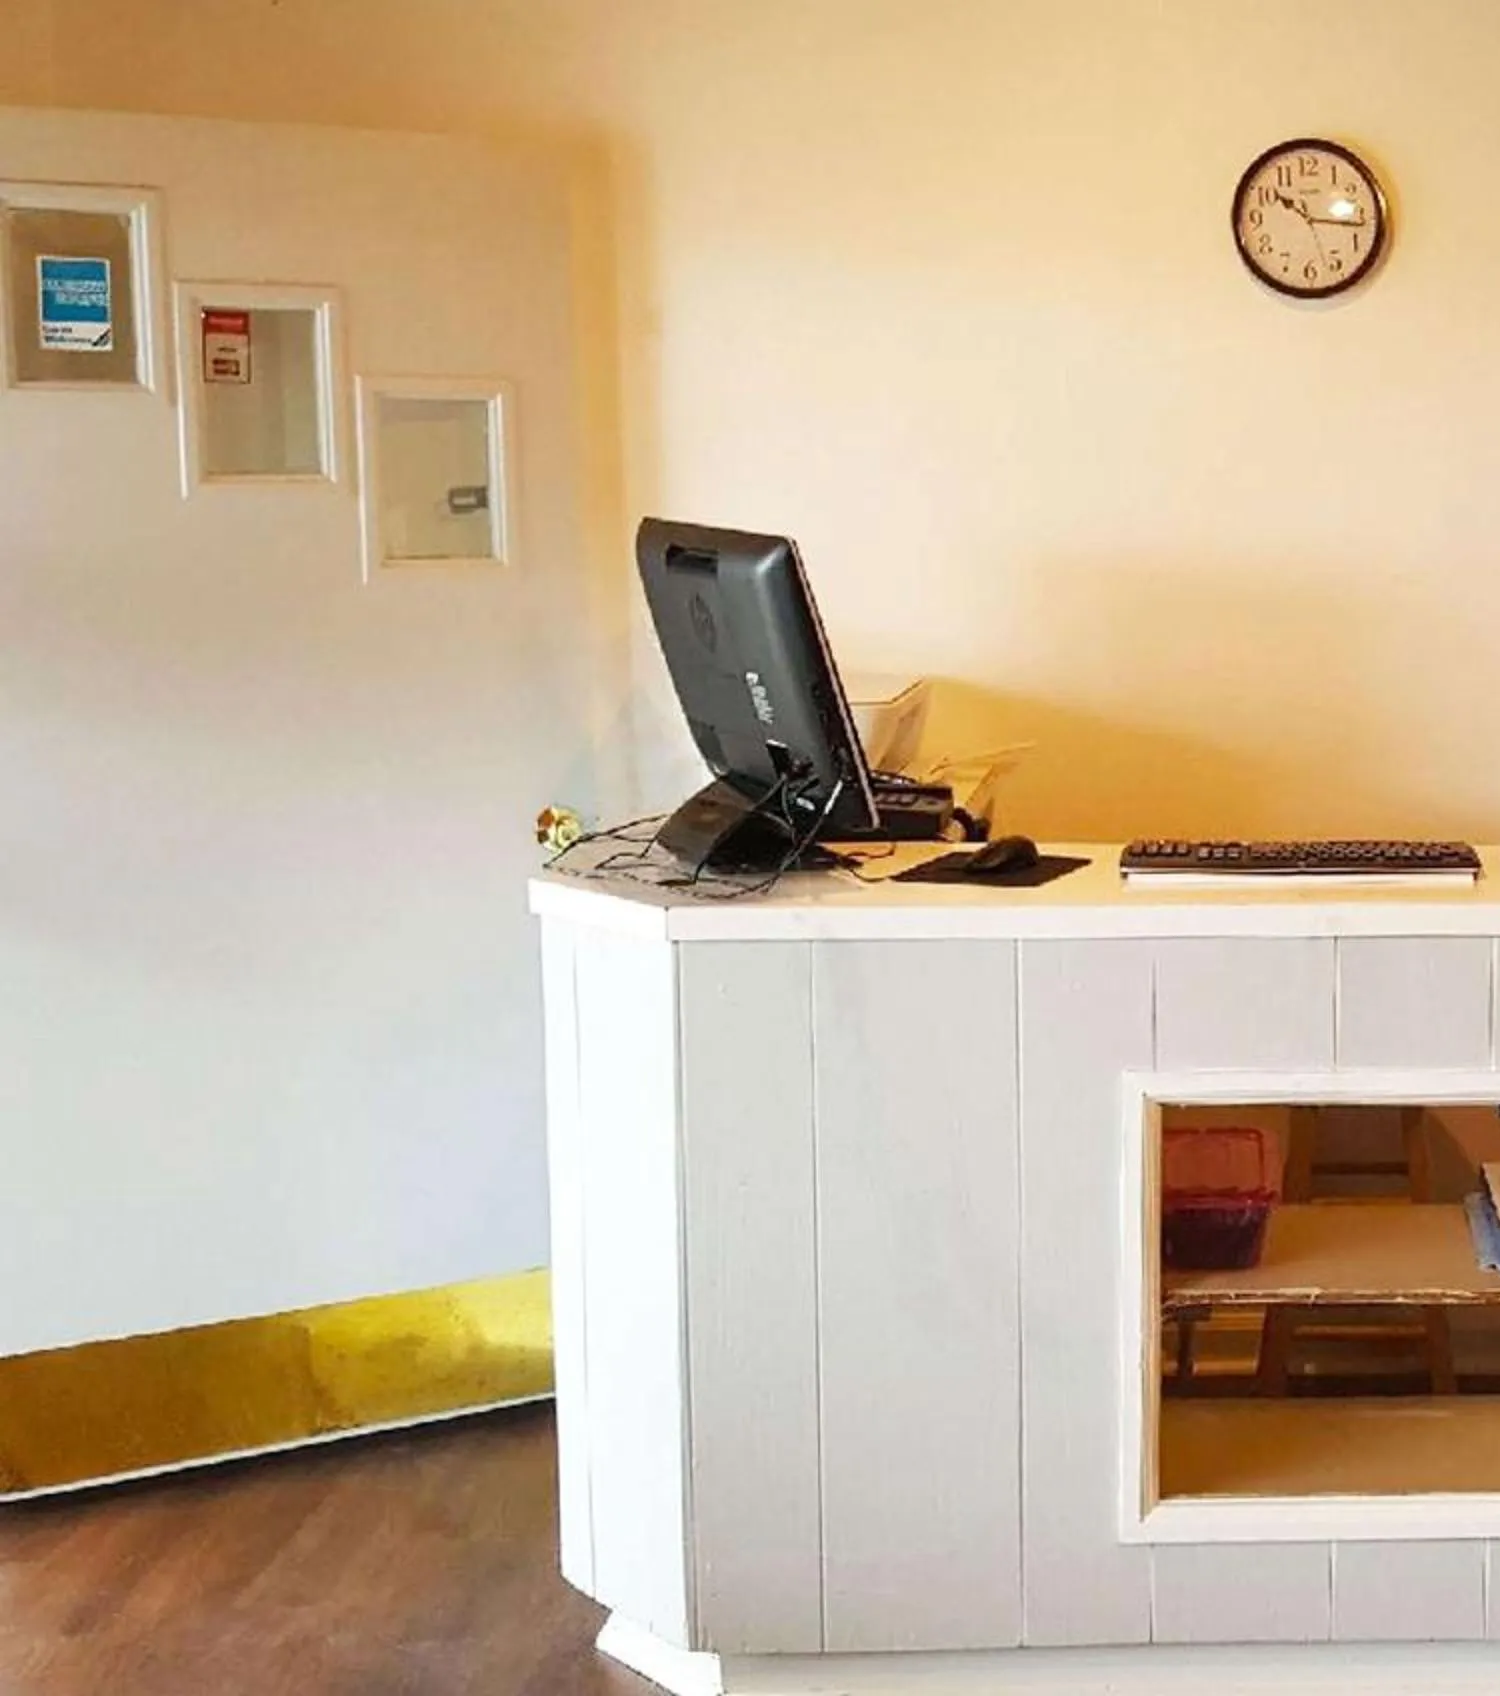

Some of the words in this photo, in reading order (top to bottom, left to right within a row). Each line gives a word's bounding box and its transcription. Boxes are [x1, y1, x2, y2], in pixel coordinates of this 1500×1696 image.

[1277, 165, 1292, 187] 11
[1298, 157, 1318, 176] 12
[1331, 165, 1337, 185] 1
[1258, 186, 1279, 207] 10
[1249, 209, 1263, 231] 9
[1303, 259, 1318, 279] 6
[1329, 249, 1342, 272] 5
